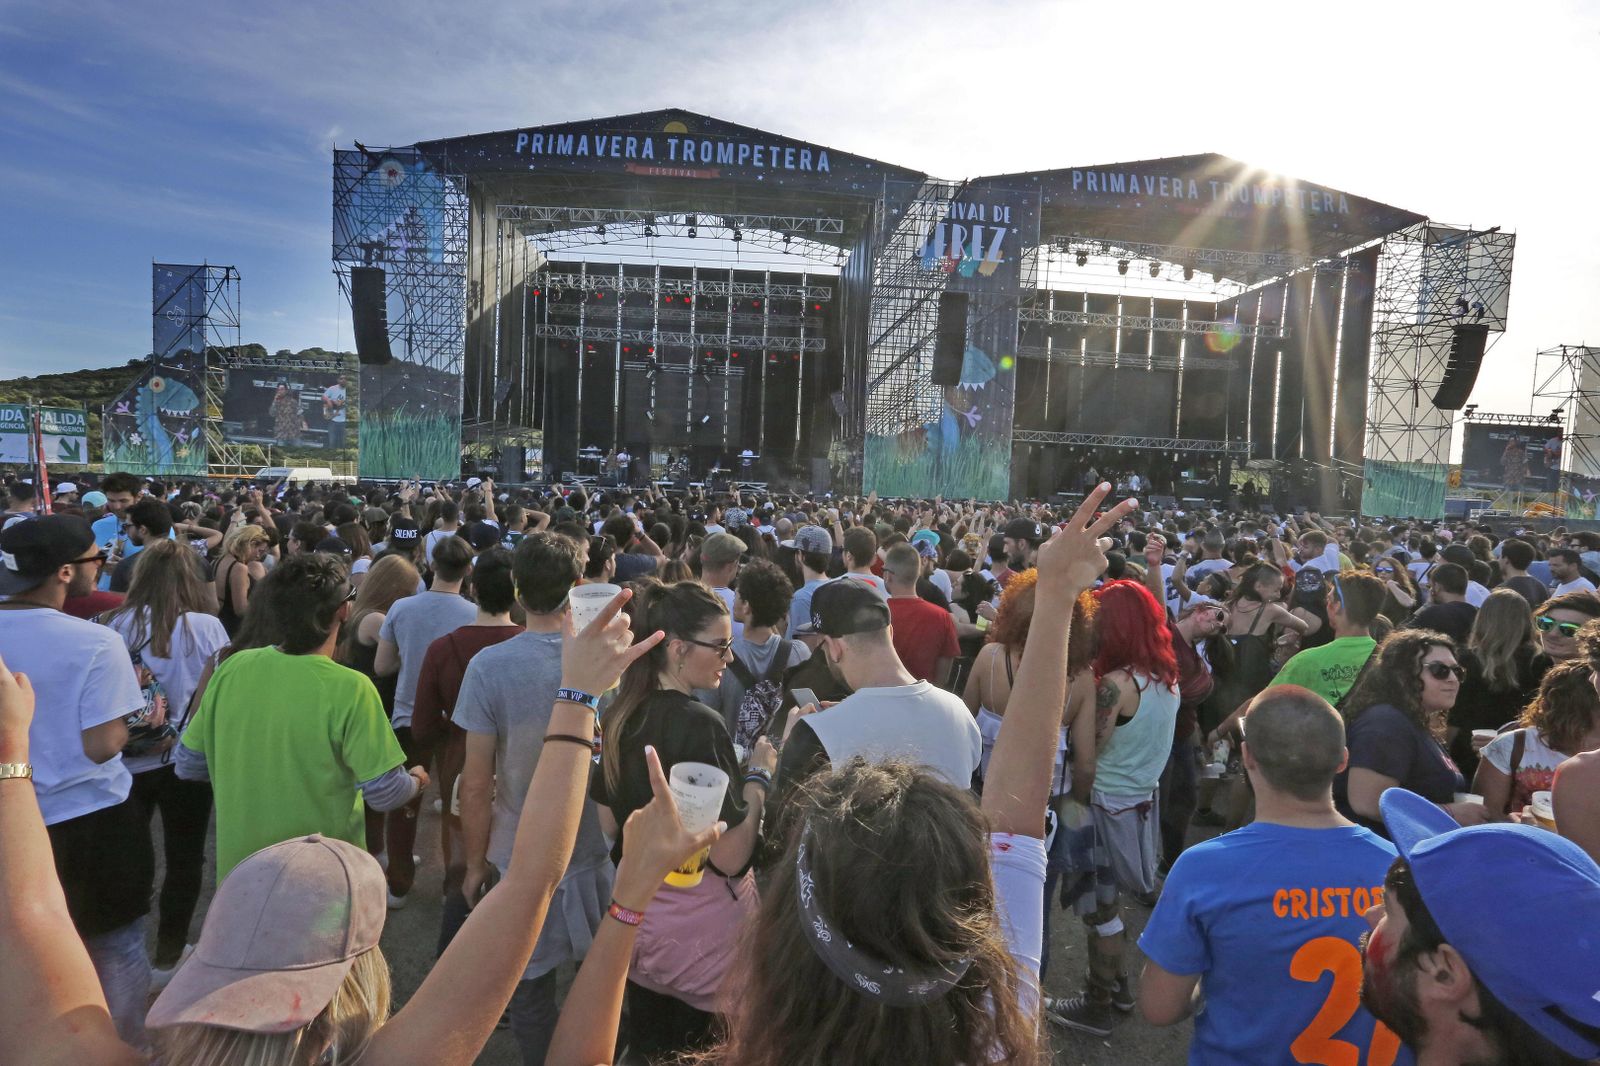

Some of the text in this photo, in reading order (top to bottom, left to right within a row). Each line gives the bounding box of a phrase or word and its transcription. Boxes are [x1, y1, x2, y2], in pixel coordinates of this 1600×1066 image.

[516, 132, 831, 172] PRIMAVERA TROMPETERA
[649, 167, 697, 178] FESTIVAL
[1072, 170, 1350, 214] PRIMAVERA TROMPETERA
[951, 201, 1012, 224] IVAL DE
[0, 409, 25, 422] IDA
[0, 422, 26, 430] GENCIA
[394, 528, 418, 539] SILENCE
[571, 691, 583, 702] VIP
